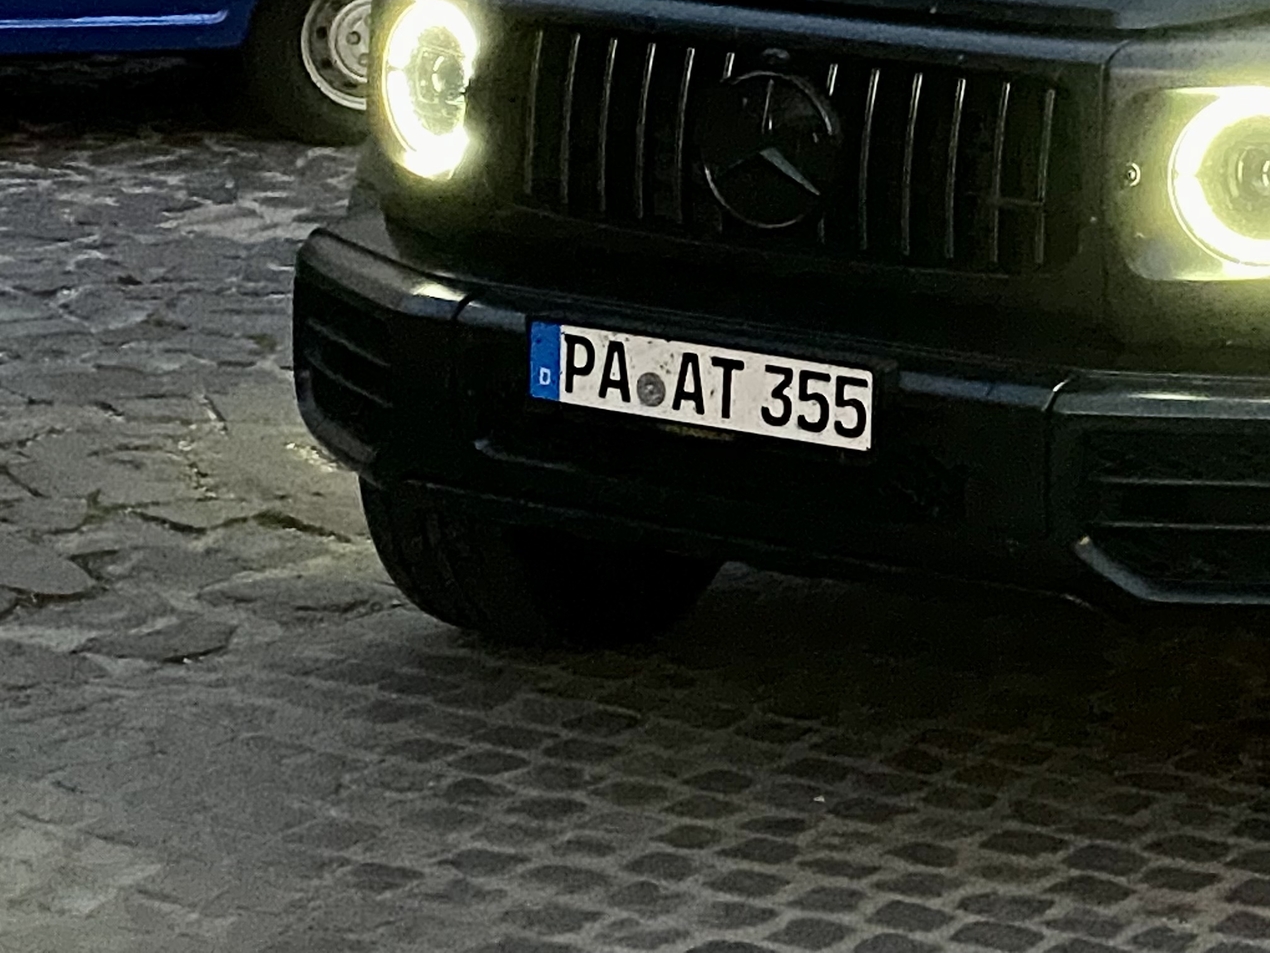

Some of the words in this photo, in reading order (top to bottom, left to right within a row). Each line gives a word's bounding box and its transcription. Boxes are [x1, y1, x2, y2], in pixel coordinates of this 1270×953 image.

[539, 367, 551, 385] D
[564, 333, 631, 403] PA
[672, 352, 745, 419] AT
[760, 363, 869, 439] 355
